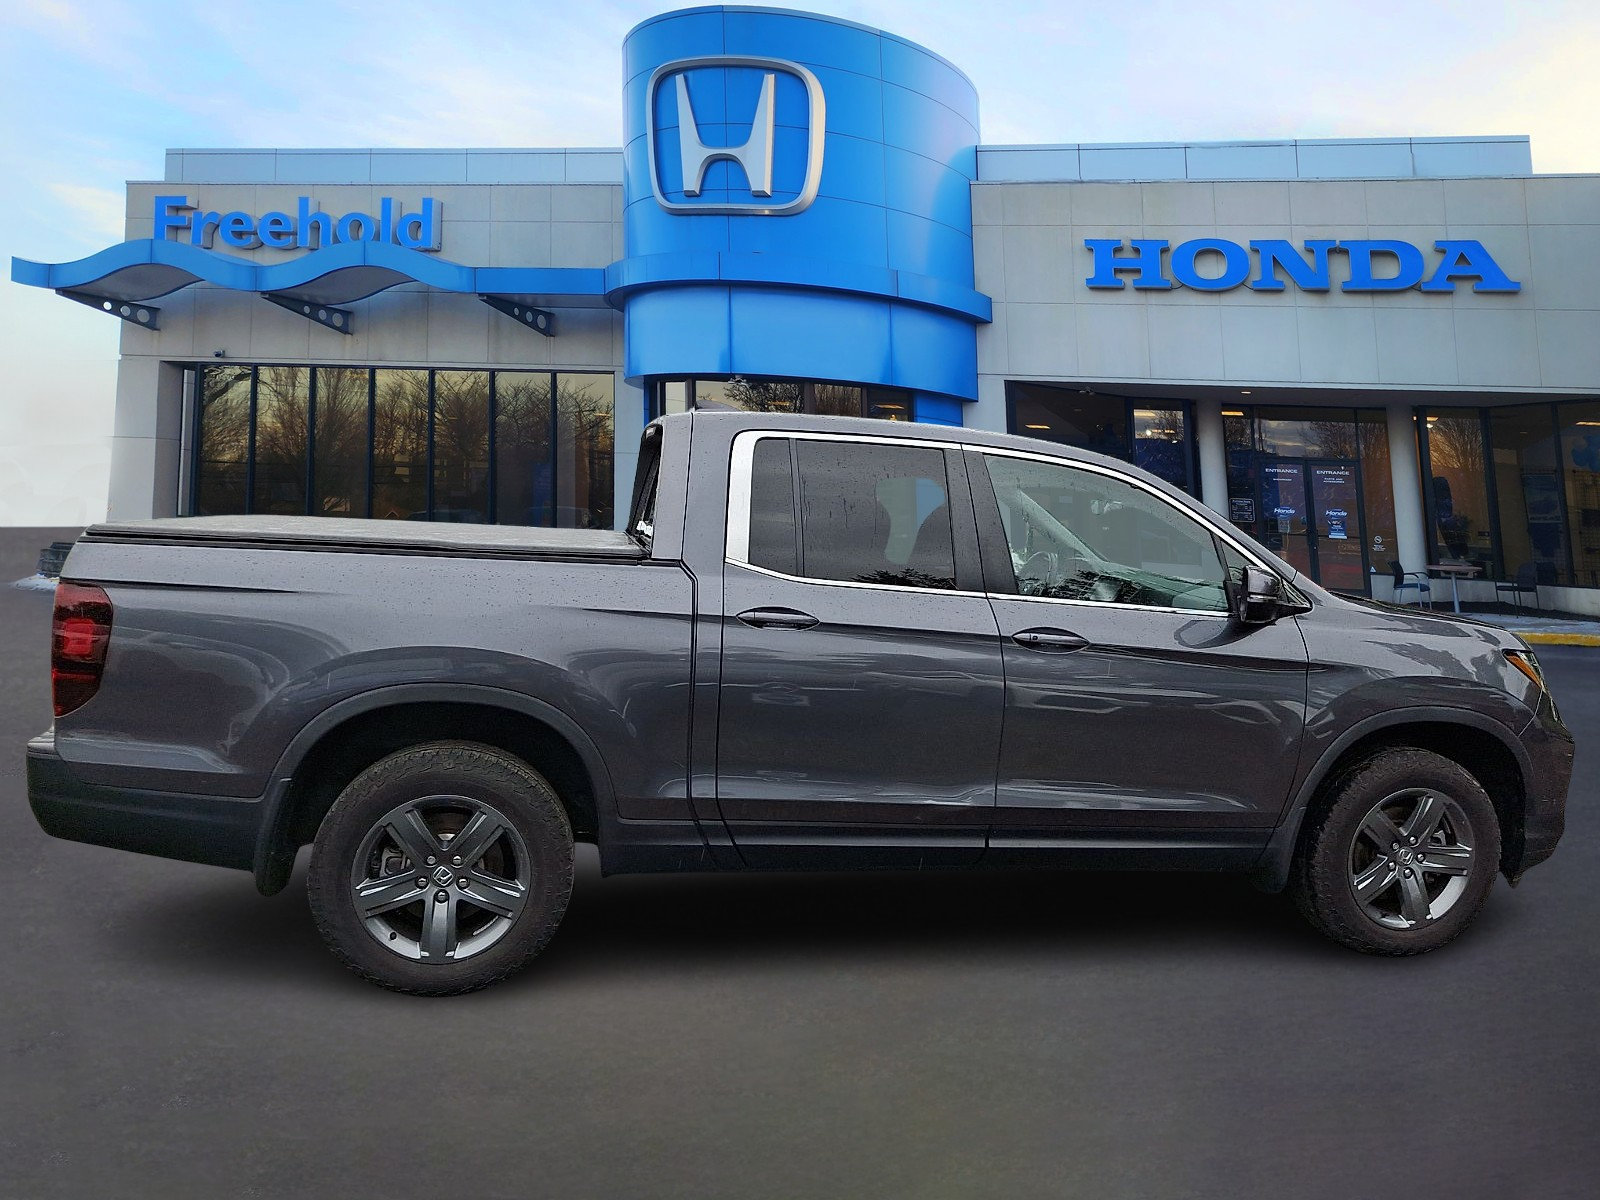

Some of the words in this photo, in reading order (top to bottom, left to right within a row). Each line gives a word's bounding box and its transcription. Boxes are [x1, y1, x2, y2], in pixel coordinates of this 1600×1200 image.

[154, 195, 440, 249] Freehold
[1084, 238, 1522, 292] HONDA
[1274, 507, 1296, 515] Honda
